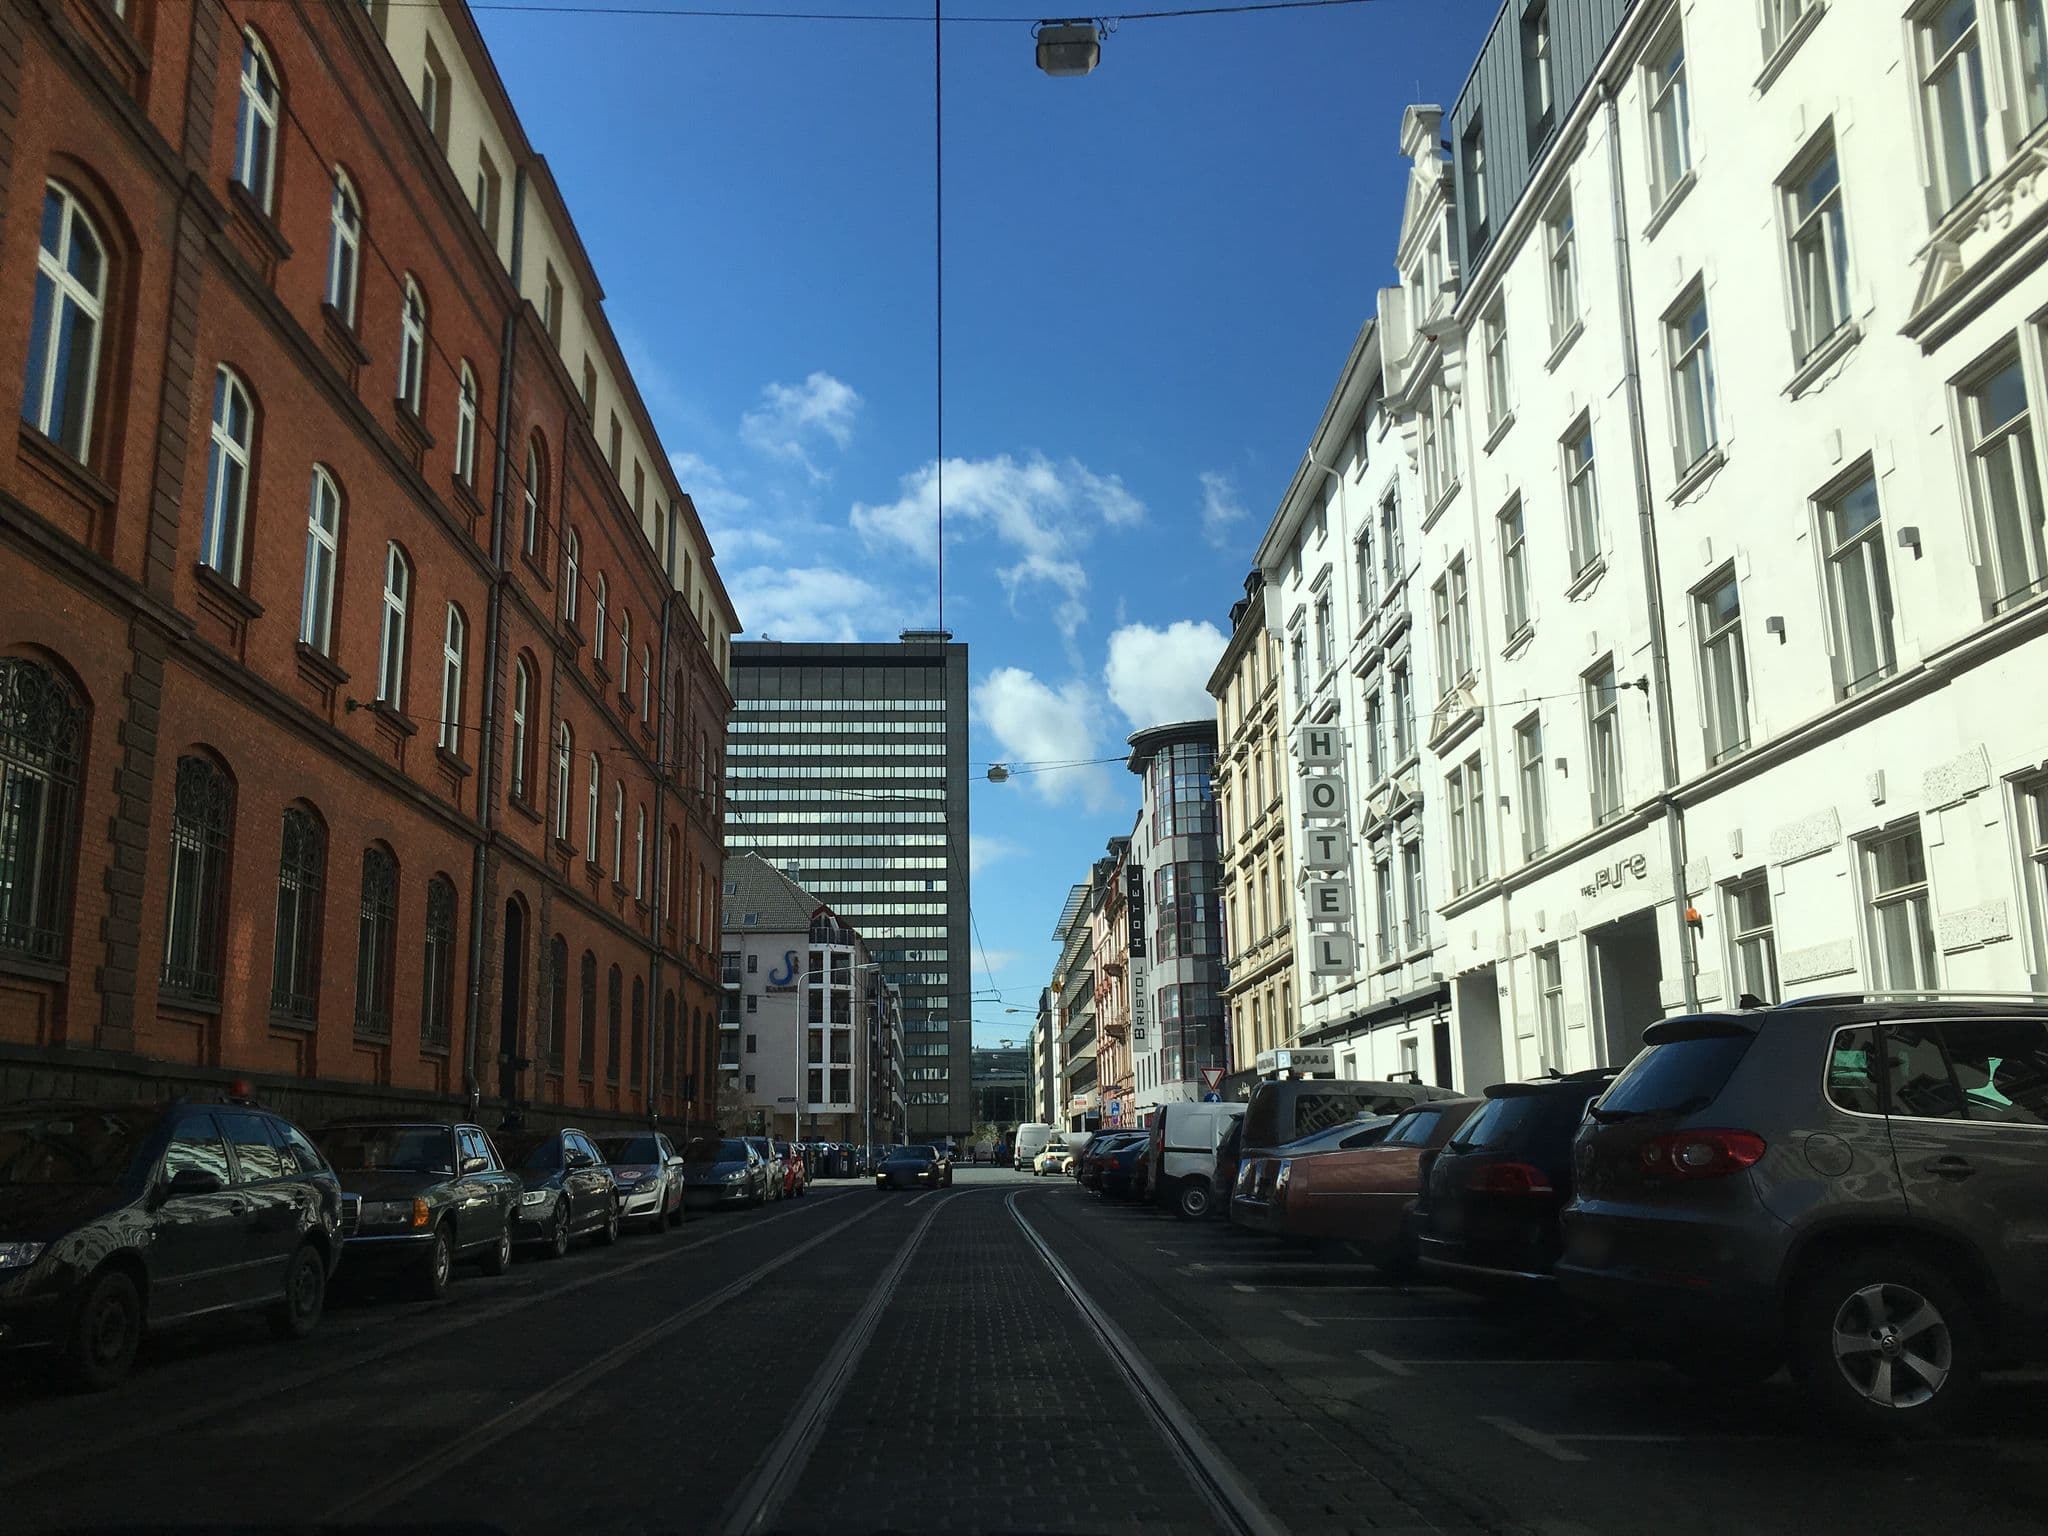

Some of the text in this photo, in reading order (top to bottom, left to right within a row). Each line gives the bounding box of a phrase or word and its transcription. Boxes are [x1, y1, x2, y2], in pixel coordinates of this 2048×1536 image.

[1310, 732, 1342, 965] HOTEL
[1132, 873, 1145, 1040] BRISTOL HOTEL
